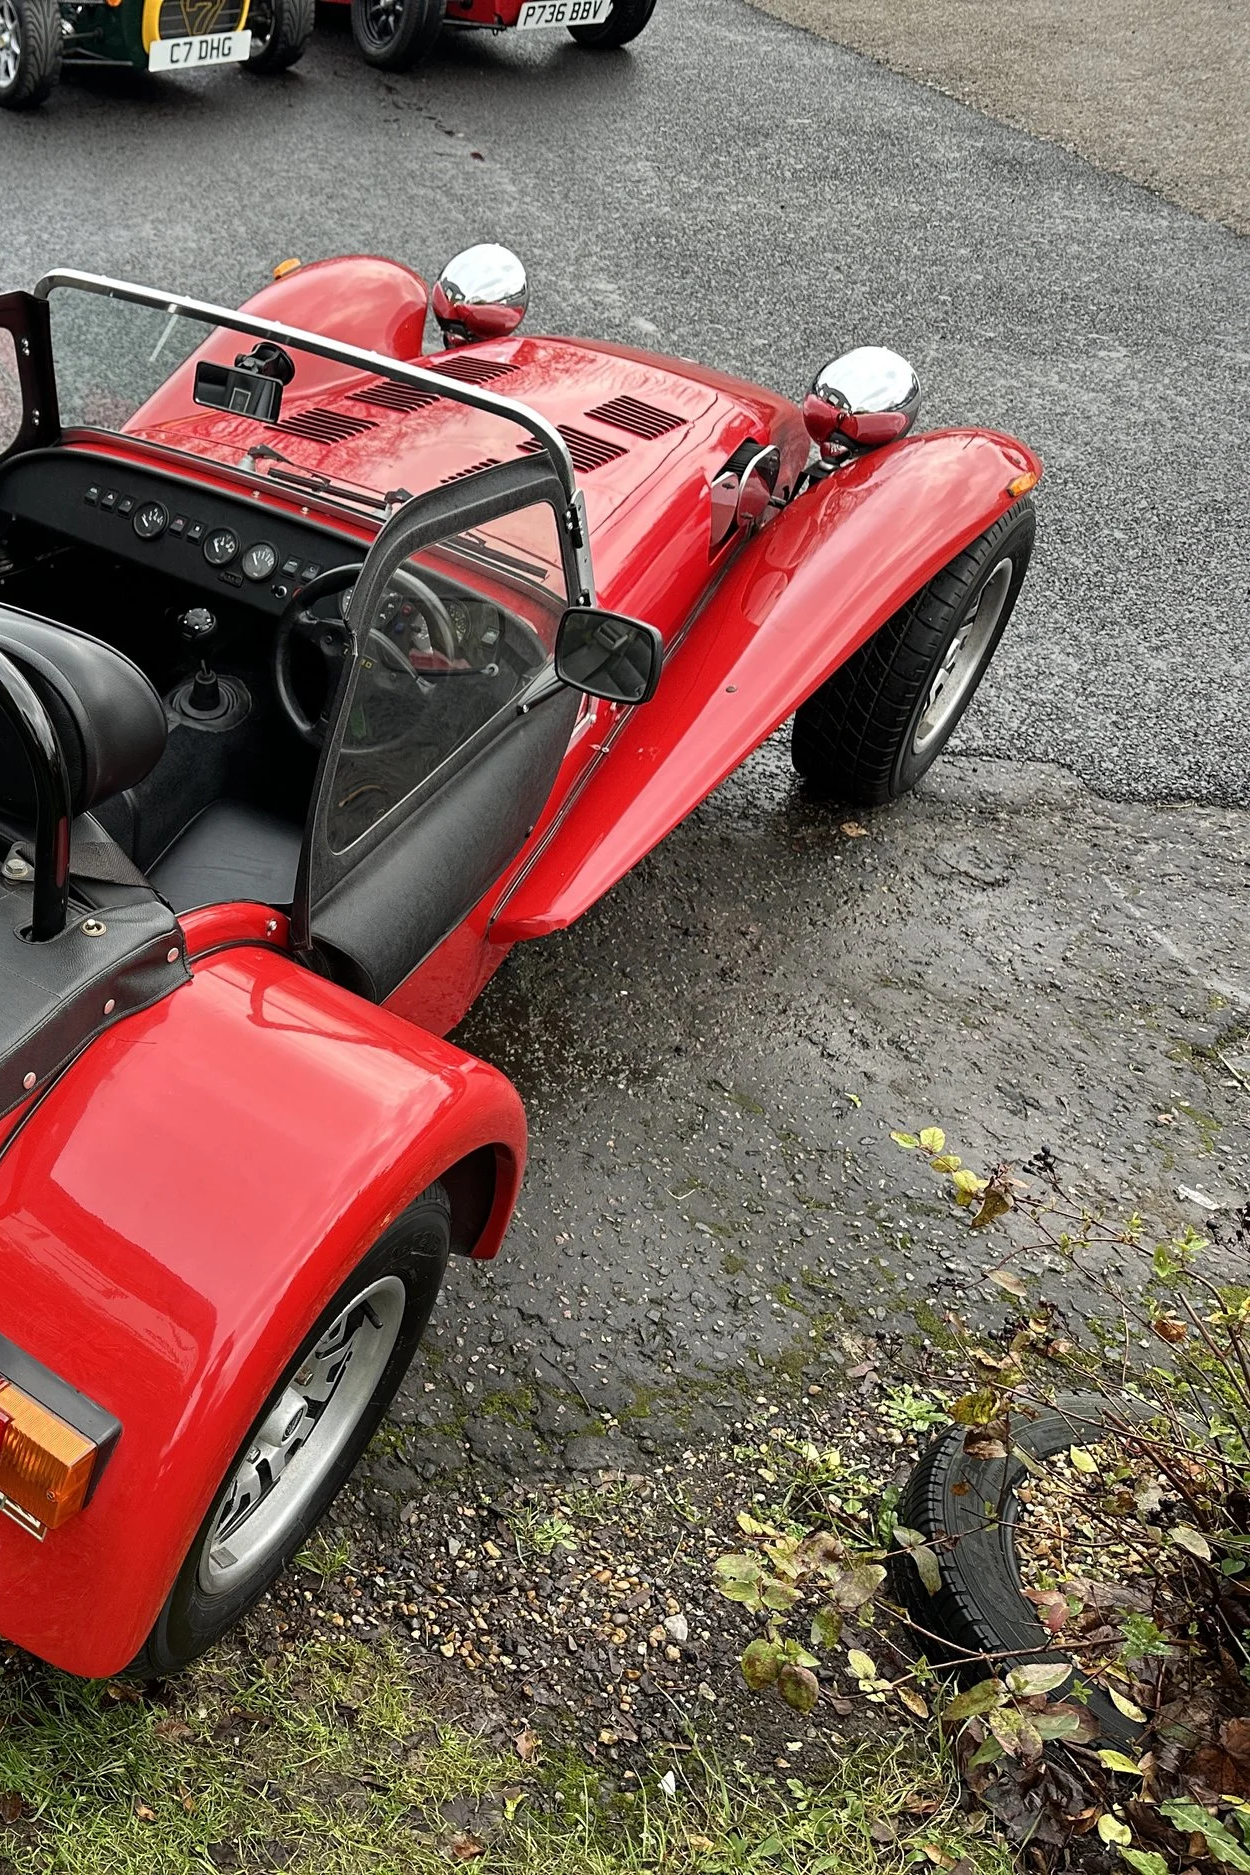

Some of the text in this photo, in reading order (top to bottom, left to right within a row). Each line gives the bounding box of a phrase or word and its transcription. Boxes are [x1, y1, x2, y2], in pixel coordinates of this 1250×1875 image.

[523, 0, 602, 26] P736 BBV
[170, 37, 232, 64] C7 DHG
